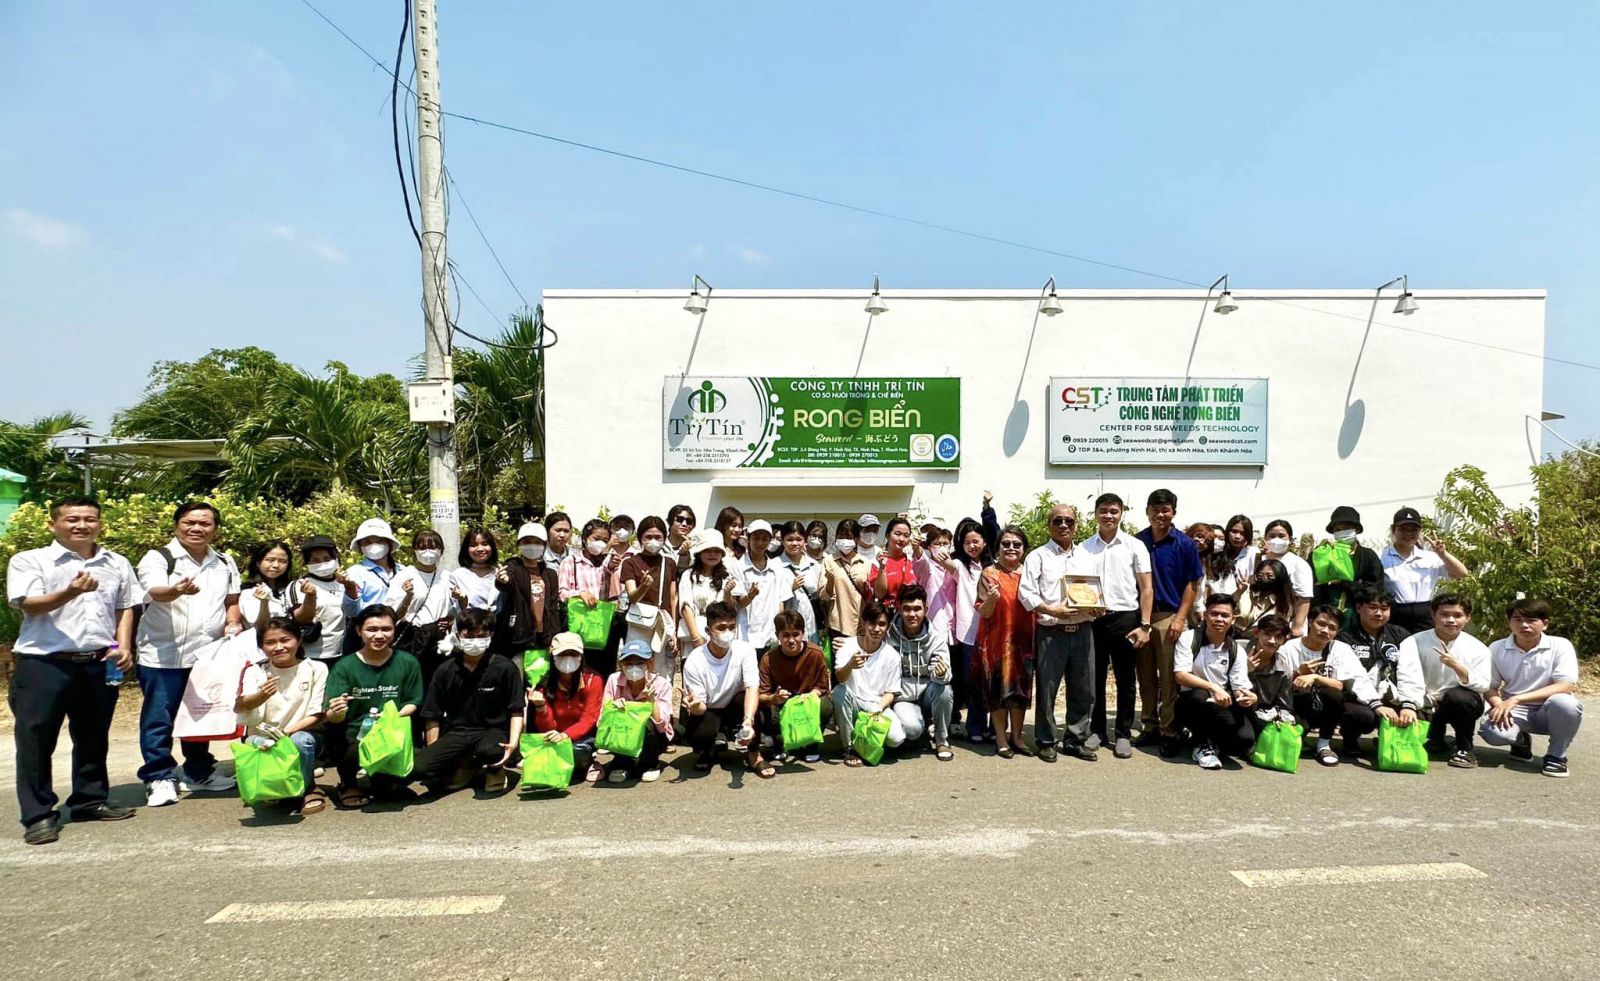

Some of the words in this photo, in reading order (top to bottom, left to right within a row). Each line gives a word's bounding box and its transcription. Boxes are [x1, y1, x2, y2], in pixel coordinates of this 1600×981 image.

[790, 379, 826, 391] CÔNG
[830, 381, 844, 391] TY
[848, 381, 880, 391] TNHH
[885, 378, 902, 391] TRÍ
[906, 379, 925, 391] TÍN
[1061, 386, 1105, 404] CST
[1116, 386, 1153, 402] TRUNG
[1155, 385, 1179, 402] TÂM
[1181, 385, 1210, 402] PHÁT
[1212, 384, 1244, 402] TRIỂN
[1119, 403, 1150, 420] CÔNG
[1151, 403, 1181, 422] NGHỆ
[1182, 405, 1213, 421] RONG
[1215, 403, 1241, 421] BIỂN
[1099, 424, 1132, 432] CENTER
[1134, 424, 1152, 432] FOR
[1202, 425, 1260, 433] TECHNOLOGY
[815, 433, 854, 443] Seaweed
